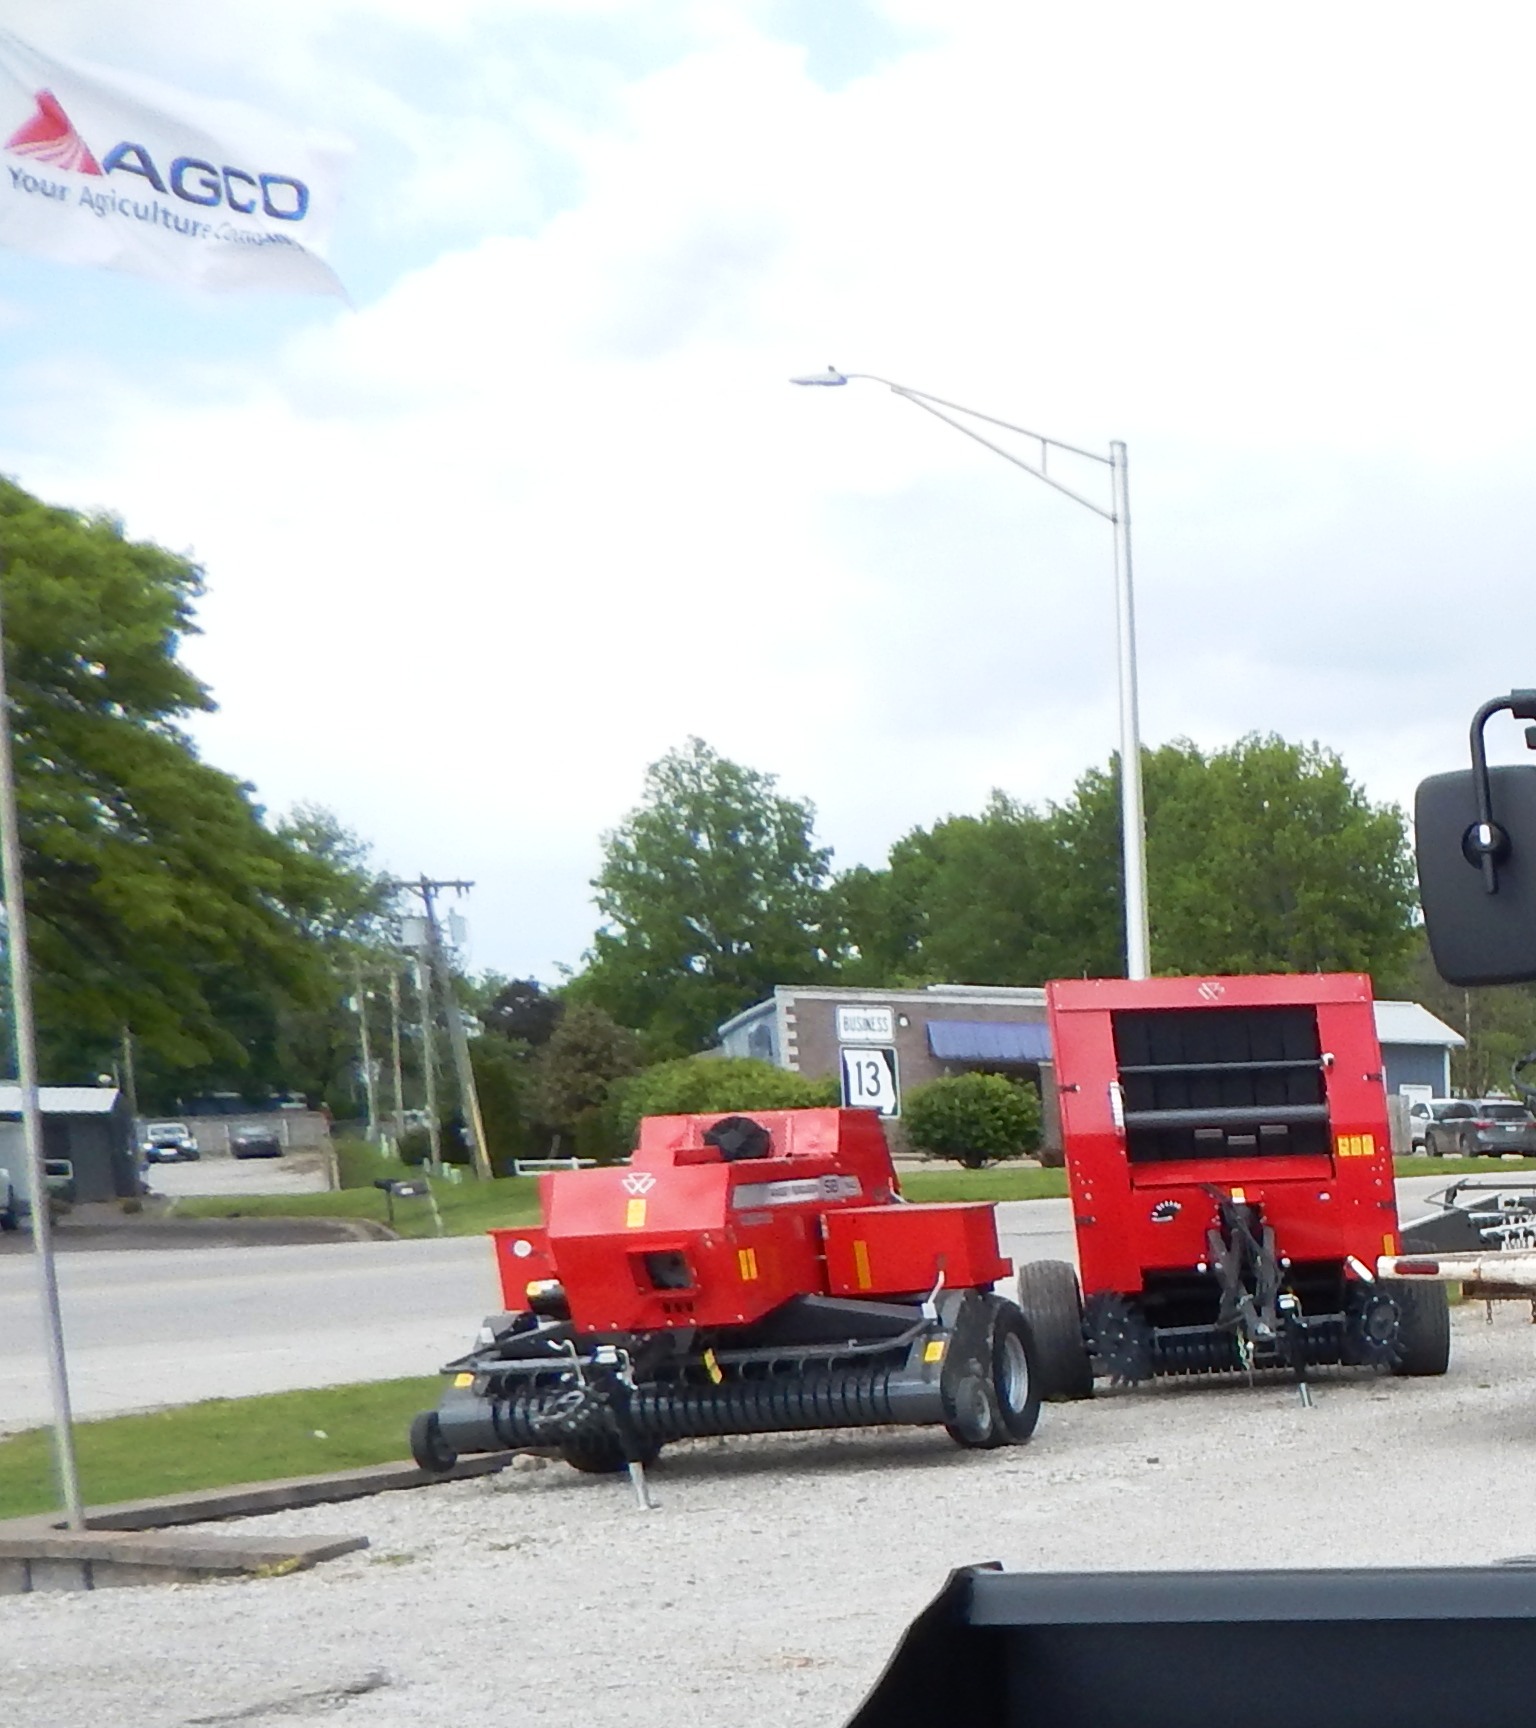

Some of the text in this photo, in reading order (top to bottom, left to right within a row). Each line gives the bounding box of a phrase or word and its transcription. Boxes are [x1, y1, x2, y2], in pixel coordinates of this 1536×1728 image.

[7, 165, 69, 202] Your
[102, 141, 310, 221] AGCO
[843, 1016, 889, 1032] BUSINESS
[856, 1060, 881, 1097] 13
